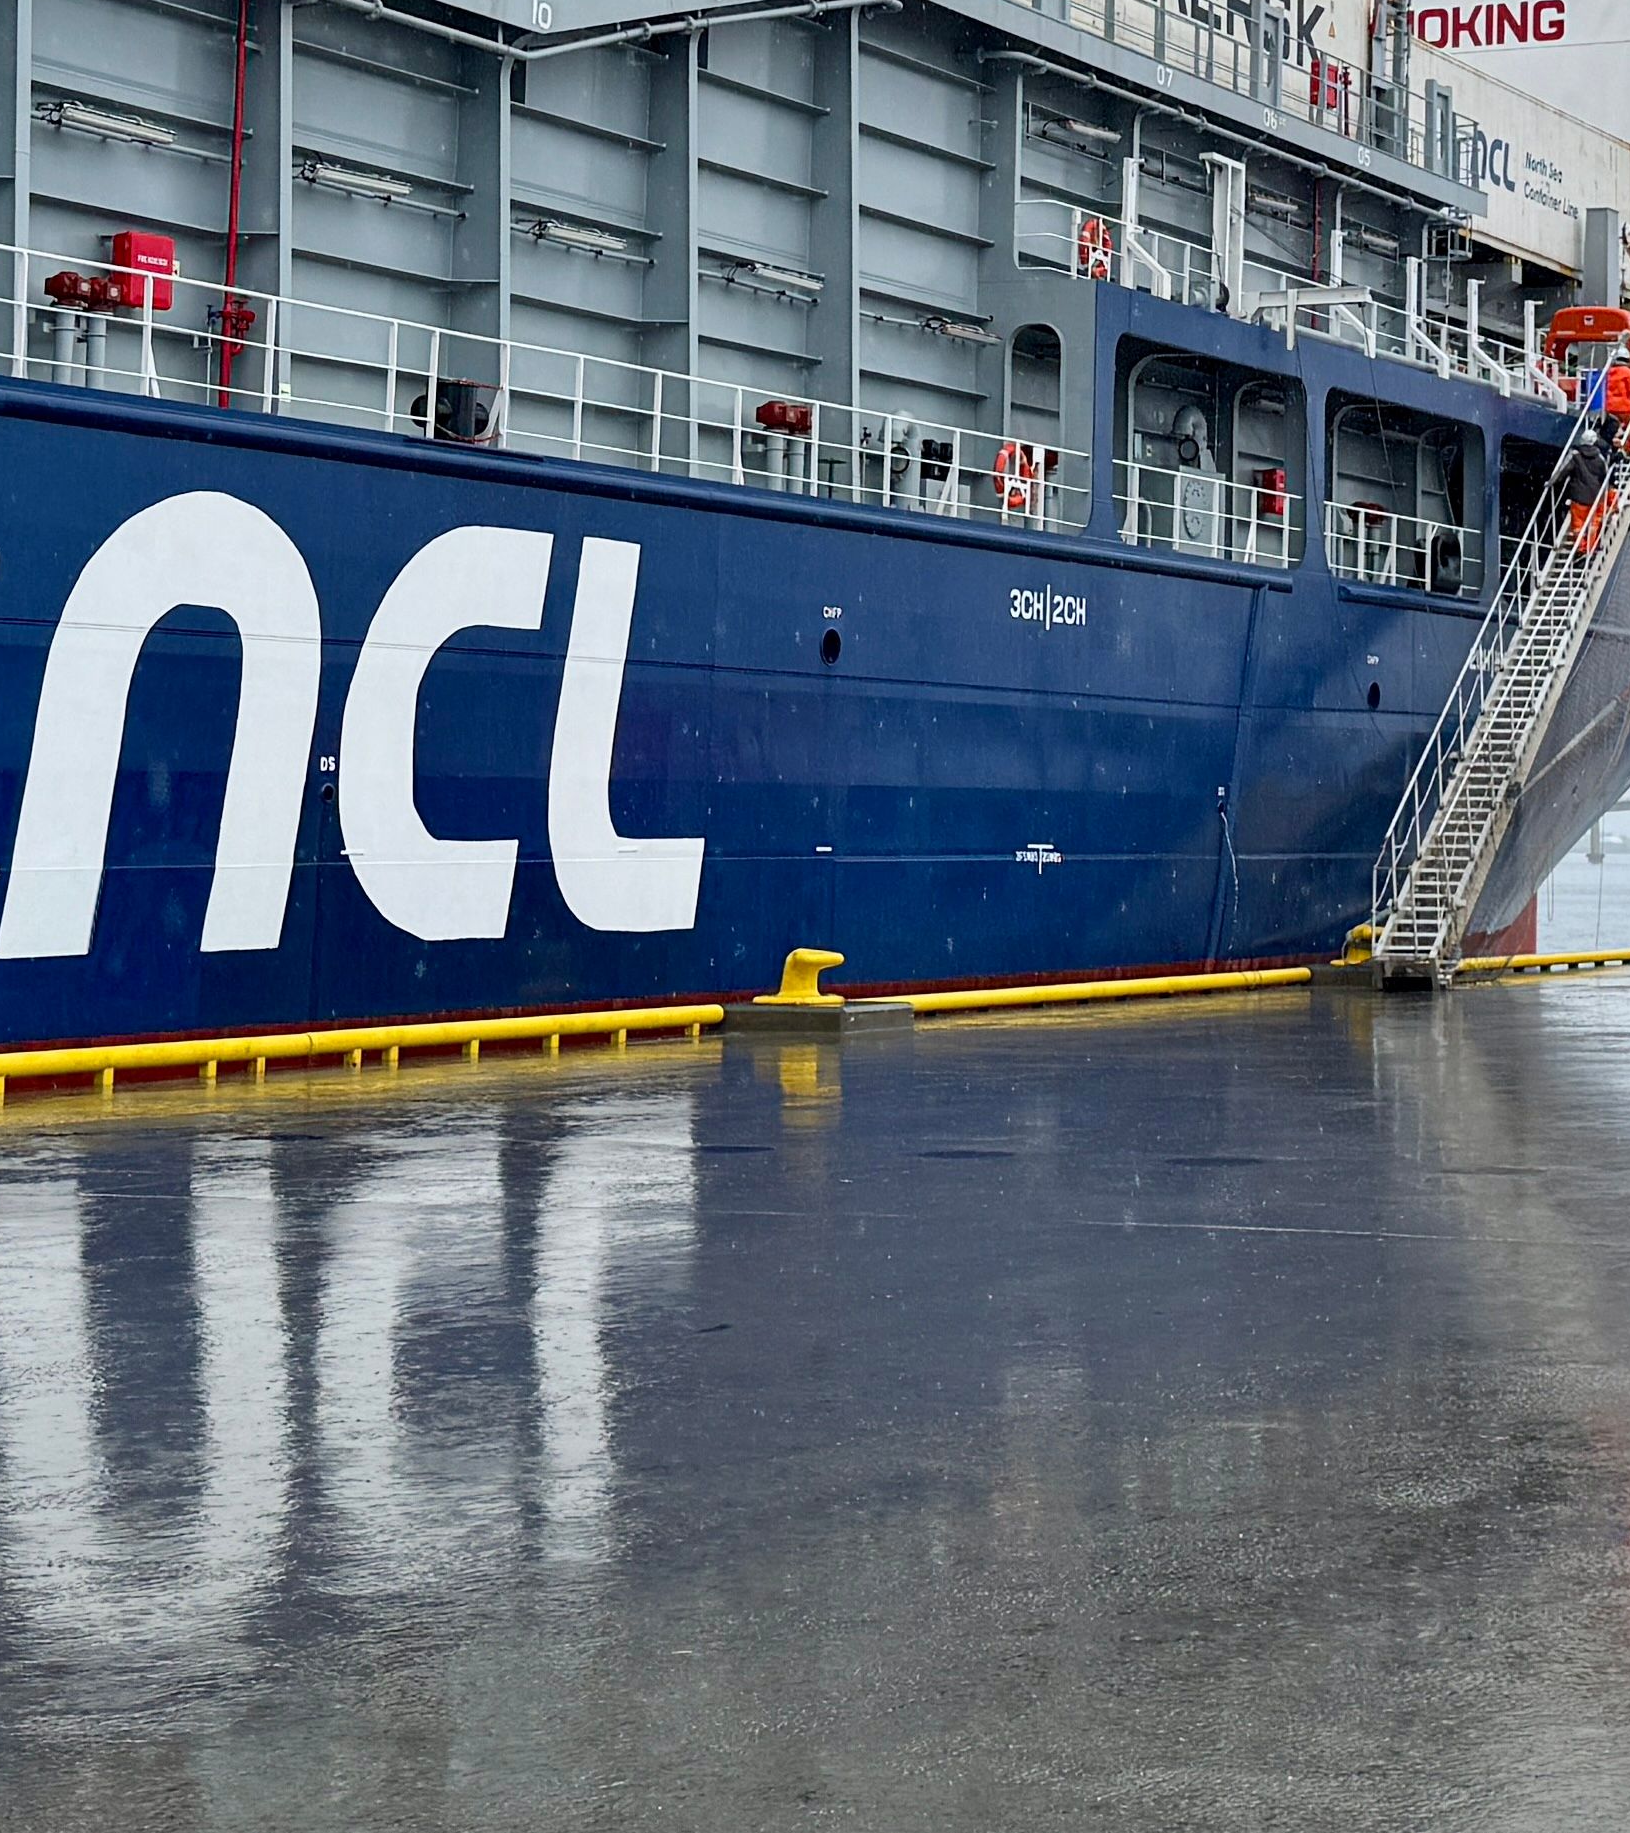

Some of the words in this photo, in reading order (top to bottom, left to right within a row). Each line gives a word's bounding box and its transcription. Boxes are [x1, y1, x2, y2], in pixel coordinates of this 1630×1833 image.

[1407, 0, 1565, 49] OKING
[1156, 64, 1175, 90] 07
[1262, 107, 1278, 130] 06
[1356, 146, 1371, 168] 05
[1525, 151, 1548, 177] North
[1523, 180, 1561, 211] Container
[320, 756, 336, 772] DS
